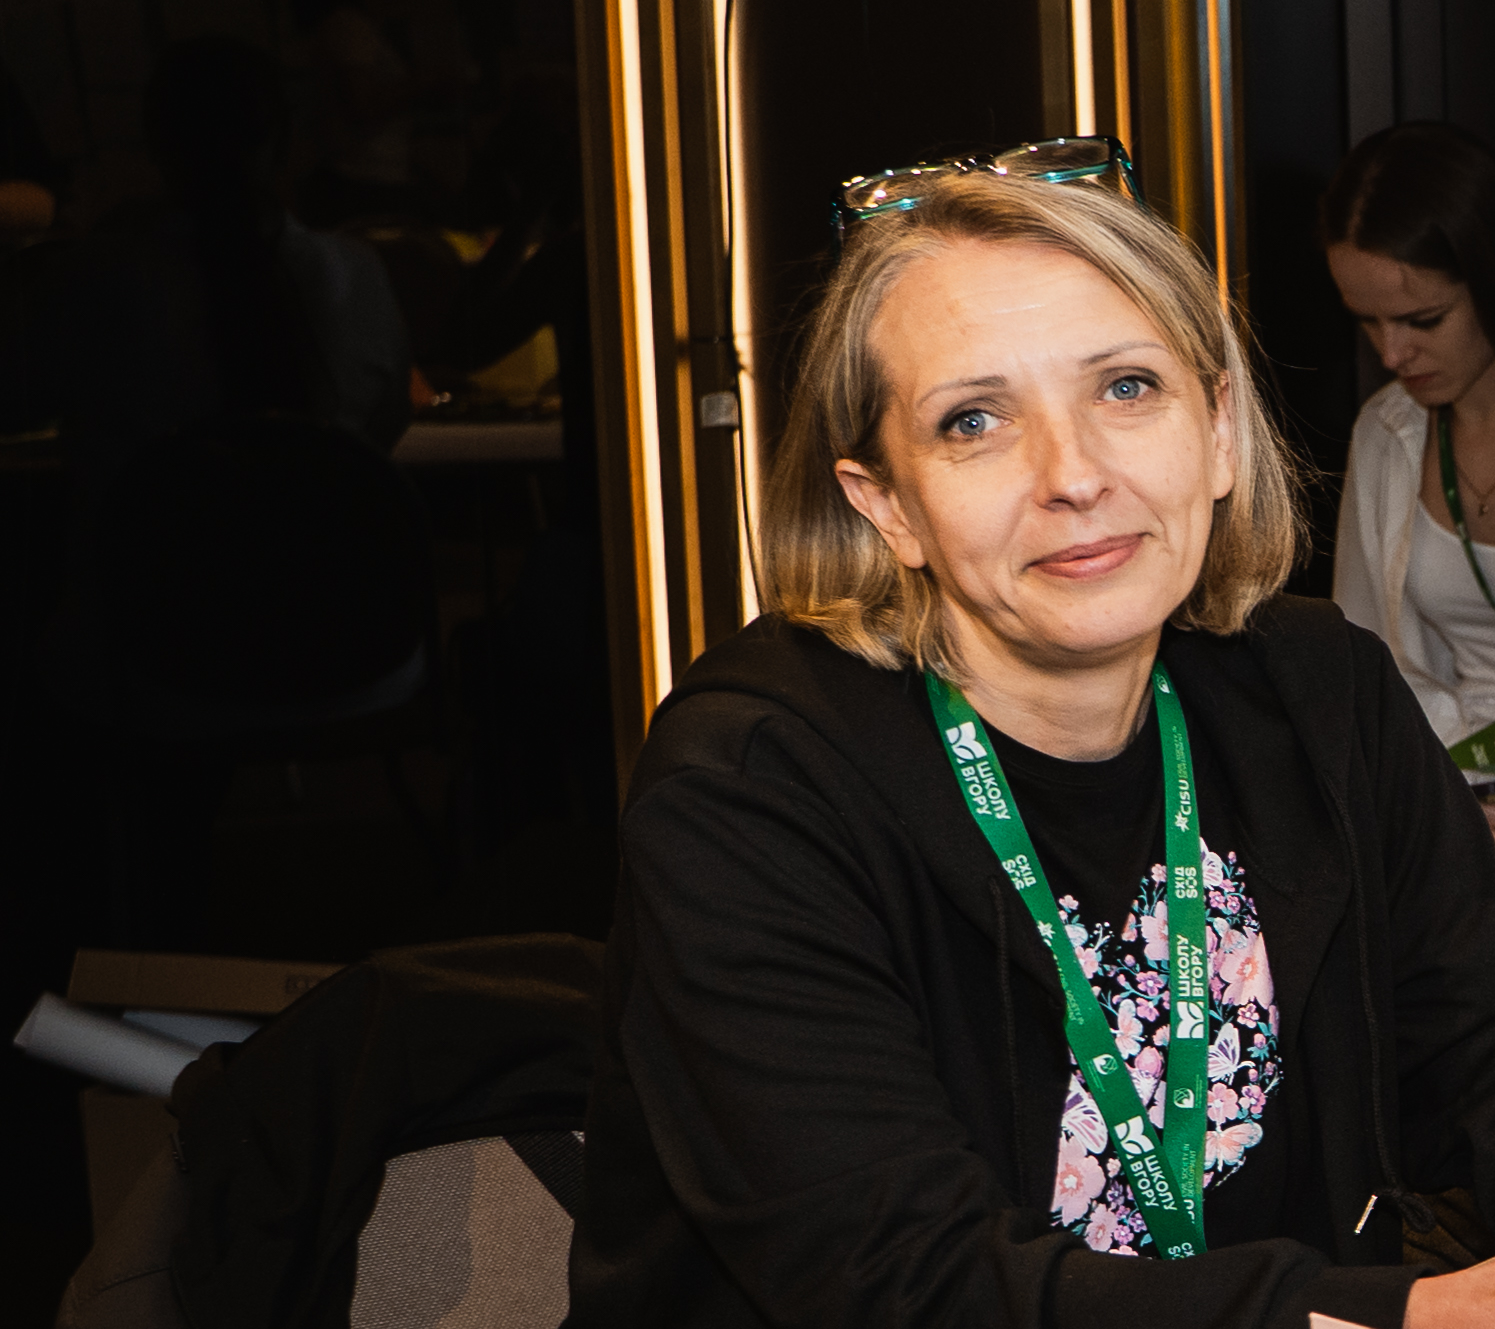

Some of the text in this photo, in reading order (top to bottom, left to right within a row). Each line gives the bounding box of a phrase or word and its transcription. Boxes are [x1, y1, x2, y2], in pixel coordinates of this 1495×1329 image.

[961, 766, 993, 815] ВГОРУ
[976, 761, 1011, 820] ШКОЛУ
[1179, 779, 1192, 816] CISU
[1015, 854, 1037, 887] СХІД
[1175, 866, 1186, 899] СХІД
[1186, 867, 1198, 899] SOS
[1177, 933, 1191, 997] ШКОЛУ
[1191, 945, 1203, 997] ВГОРУ
[1130, 1160, 1160, 1208] ВГОРУ
[1145, 1154, 1177, 1211] ШКОЛУ
